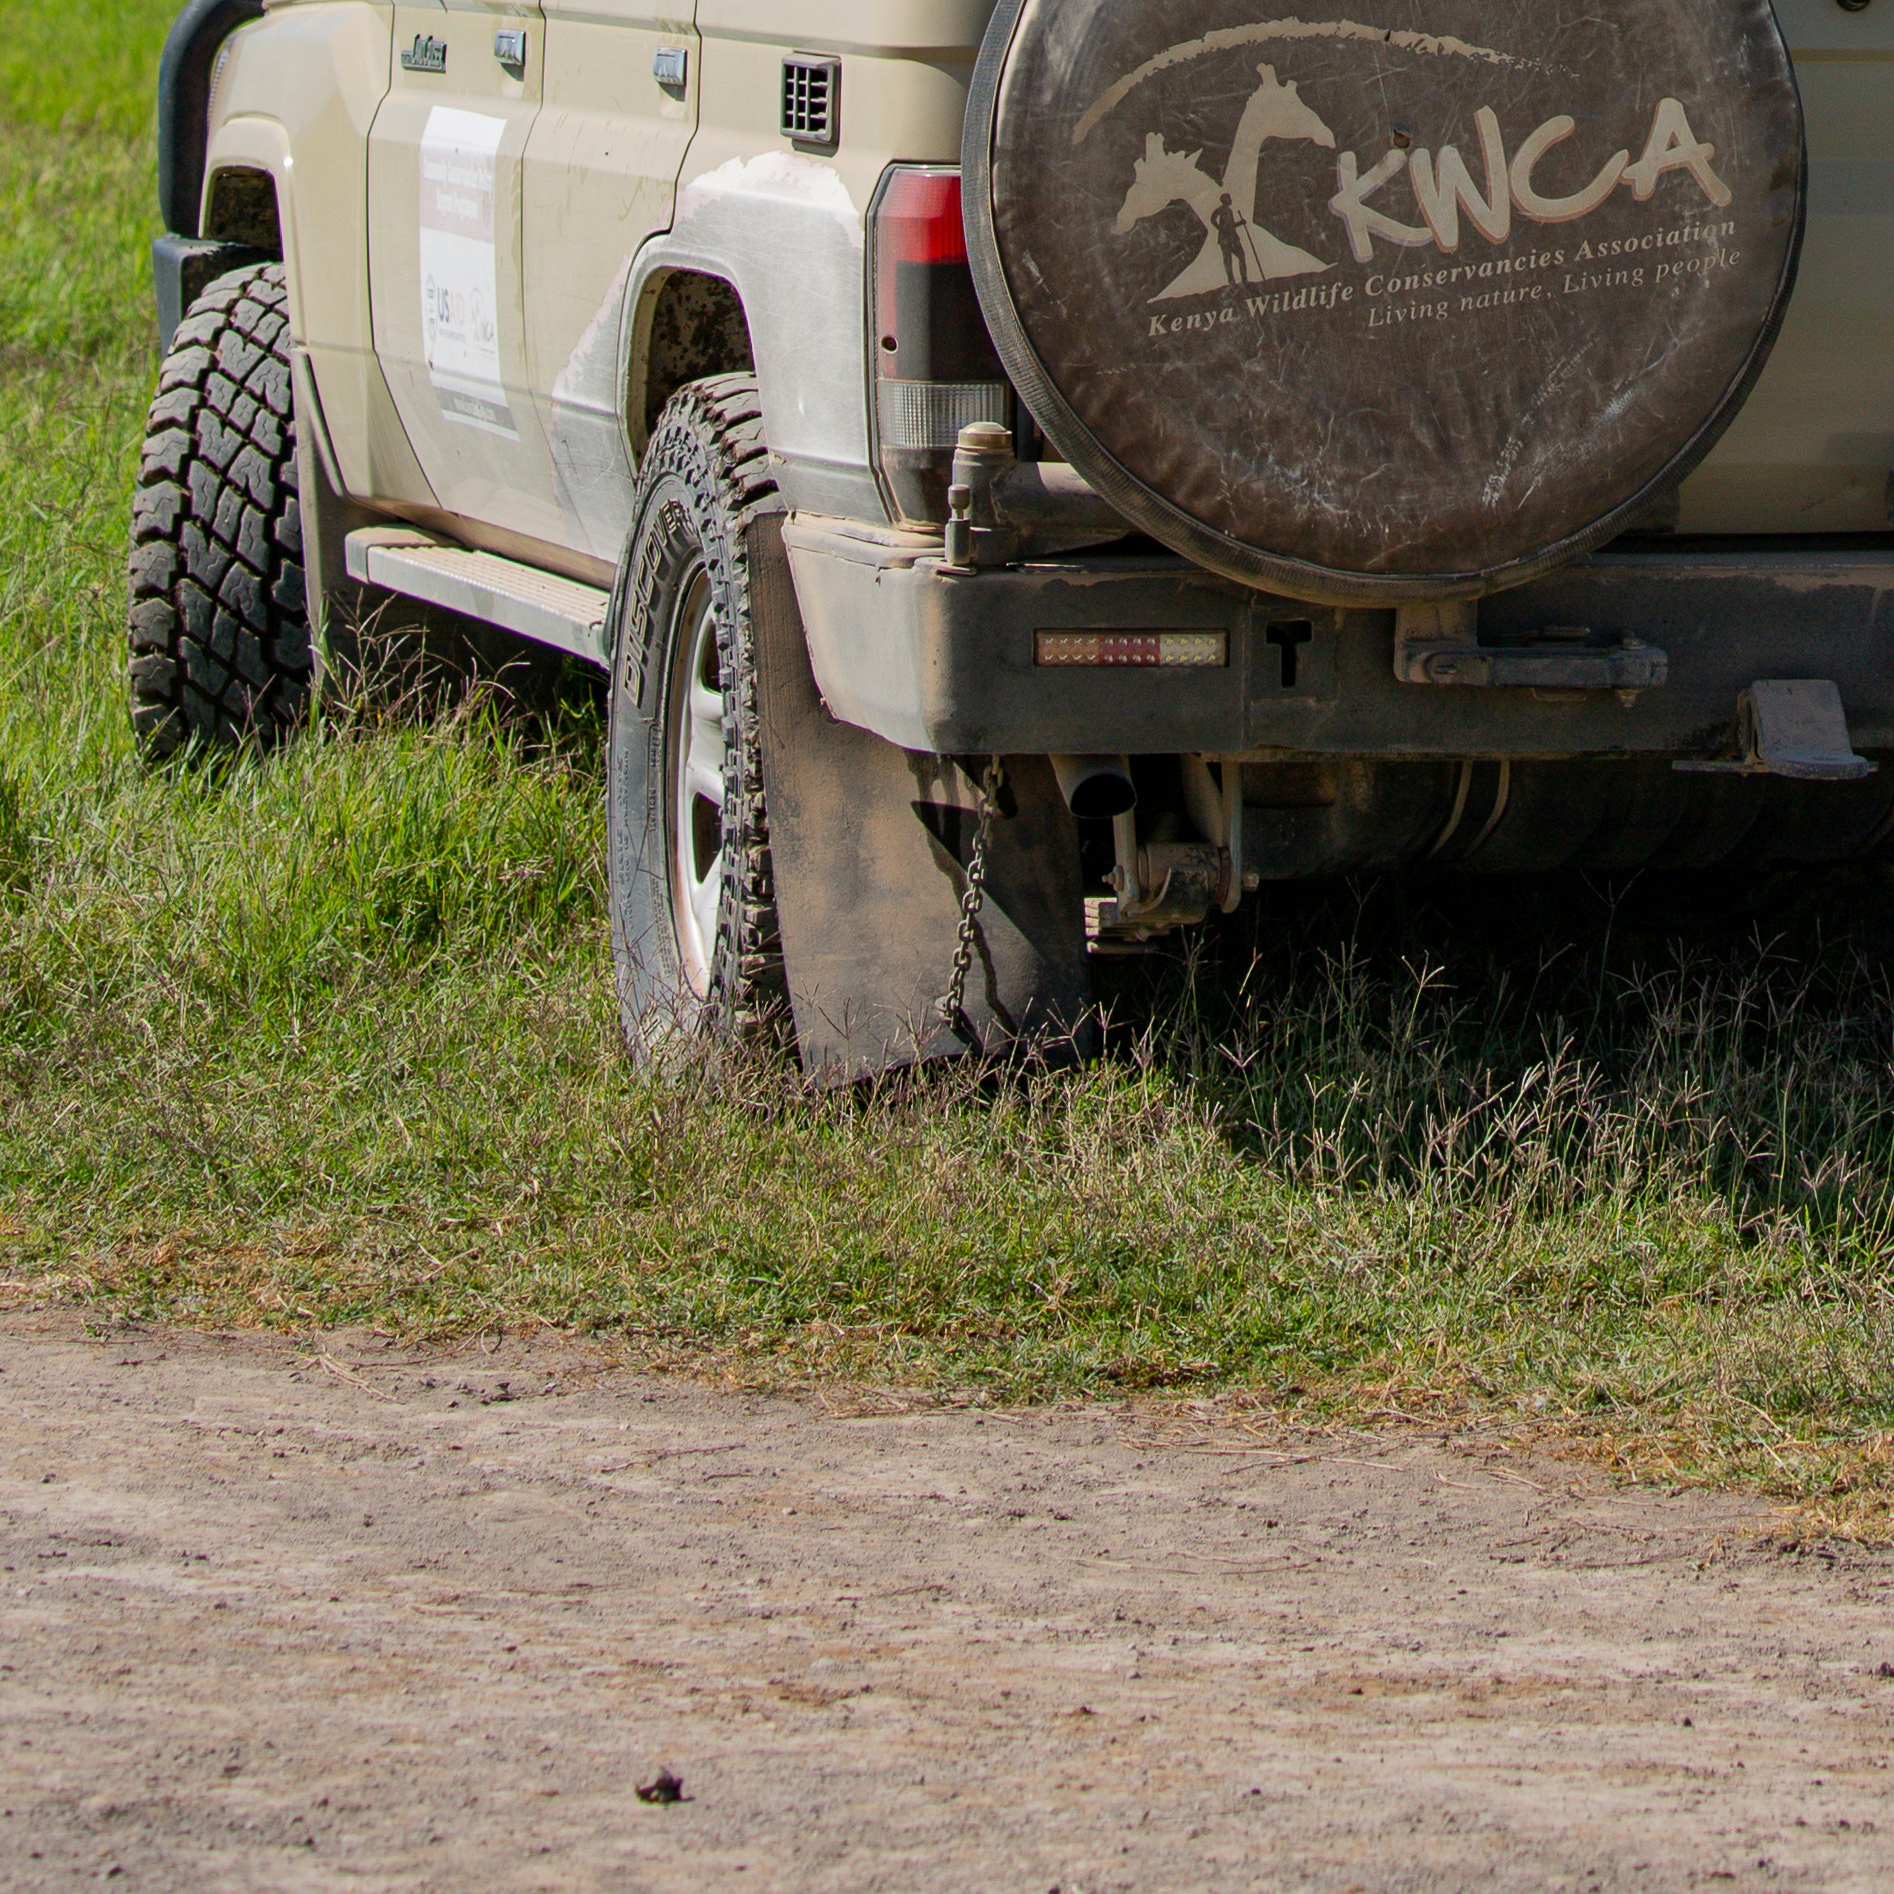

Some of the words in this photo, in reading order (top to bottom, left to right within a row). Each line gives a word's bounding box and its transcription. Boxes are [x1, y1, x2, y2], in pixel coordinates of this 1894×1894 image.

[1328, 96, 1733, 264] KWCA
[1148, 307, 1234, 337] Kenya
[1245, 282, 1354, 318] Wildlife
[1364, 248, 1565, 297] Conservancies
[1574, 220, 1736, 262] Association
[1367, 296, 1449, 328] Living
[1562, 268, 1645, 295] Living
[1655, 248, 1741, 283] people
